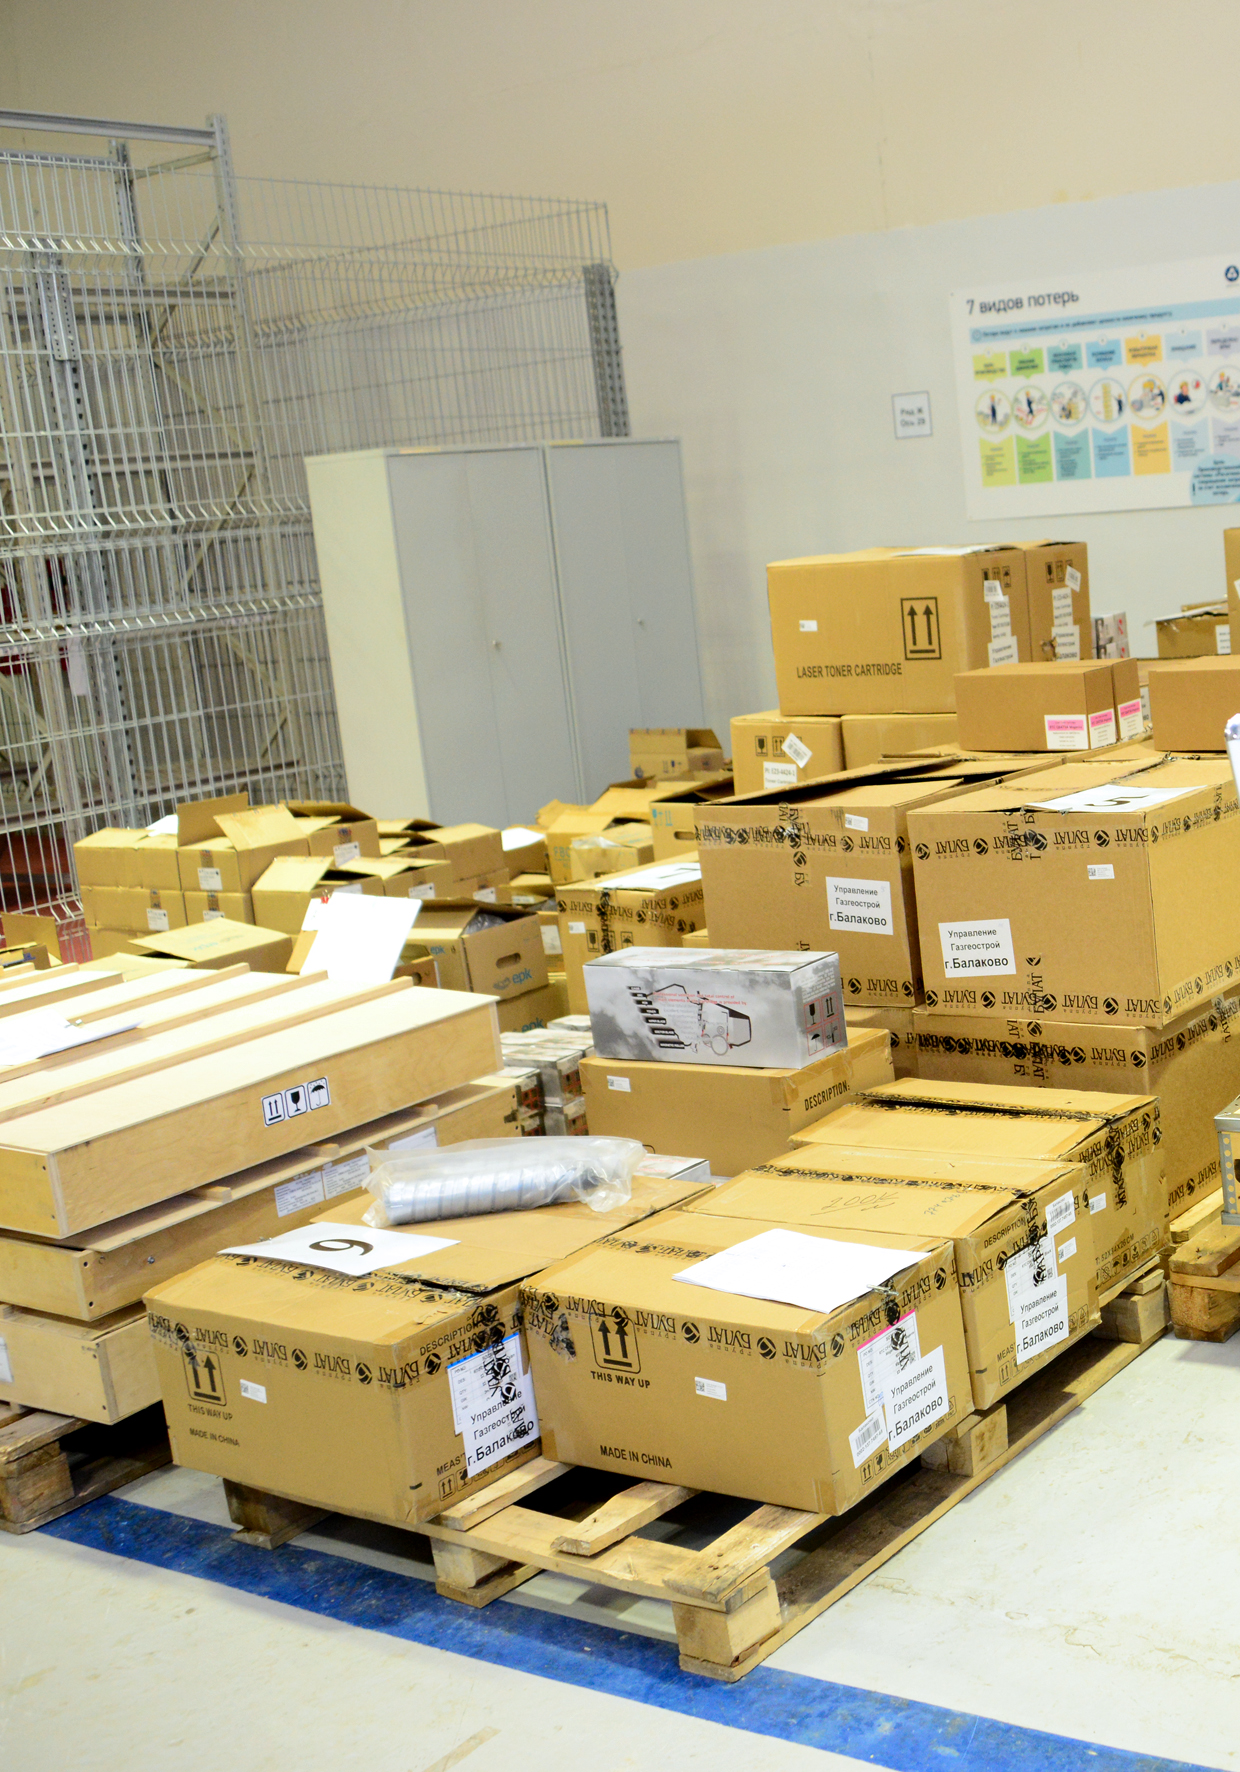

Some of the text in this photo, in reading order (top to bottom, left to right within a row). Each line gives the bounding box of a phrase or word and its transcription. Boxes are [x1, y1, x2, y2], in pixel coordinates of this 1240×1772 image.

[966, 291, 1079, 315] 7 видов потерь
[796, 662, 903, 679] LASER TONER CARTRIDGE
[859, 836, 891, 850] БУЛАТ
[935, 837, 970, 855] БУЛАТ
[1053, 829, 1090, 845] БУЛАТ
[833, 884, 878, 896] Управление
[835, 897, 881, 909] Газгеострой
[829, 911, 887, 927] г.Балаково
[948, 928, 997, 939] Управление
[430, 945, 446, 955] epk
[950, 940, 1001, 951] Газгеострой
[944, 957, 1009, 970] г.Балаково
[512, 967, 533, 985] epk
[866, 978, 899, 992] БУЛАТ
[942, 989, 977, 1003] БУЛАТ
[1062, 994, 1099, 1009] БУЛАТ
[1125, 998, 1163, 1013] БУЛАТ
[1090, 1047, 1126, 1062] БУЛАТ
[804, 1080, 851, 1111] DESCRIPTION:
[1020, 1290, 1058, 1315] Управление
[634, 1310, 677, 1334] БУЛАТ
[1021, 1302, 1059, 1330] Газгеострой
[195, 1327, 229, 1348] БУЛАТ
[707, 1325, 752, 1350] БУЛАТ
[1016, 1320, 1065, 1354] г.Балаково
[252, 1339, 289, 1361] БУЛАТ
[782, 1340, 827, 1362] БУЛАТ
[313, 1352, 351, 1375] БУЛАТ
[377, 1359, 420, 1385] БУЛАТ
[590, 1370, 651, 1389] THIS WAY UP
[890, 1364, 934, 1399] Управление
[893, 1378, 937, 1415] Газгеострой
[187, 1403, 234, 1421] THIS WAY UP
[888, 1395, 944, 1442] г.Балаково
[189, 1427, 241, 1447] MADE IN CHINA
[600, 1444, 673, 1469] MADE IN CHINA
